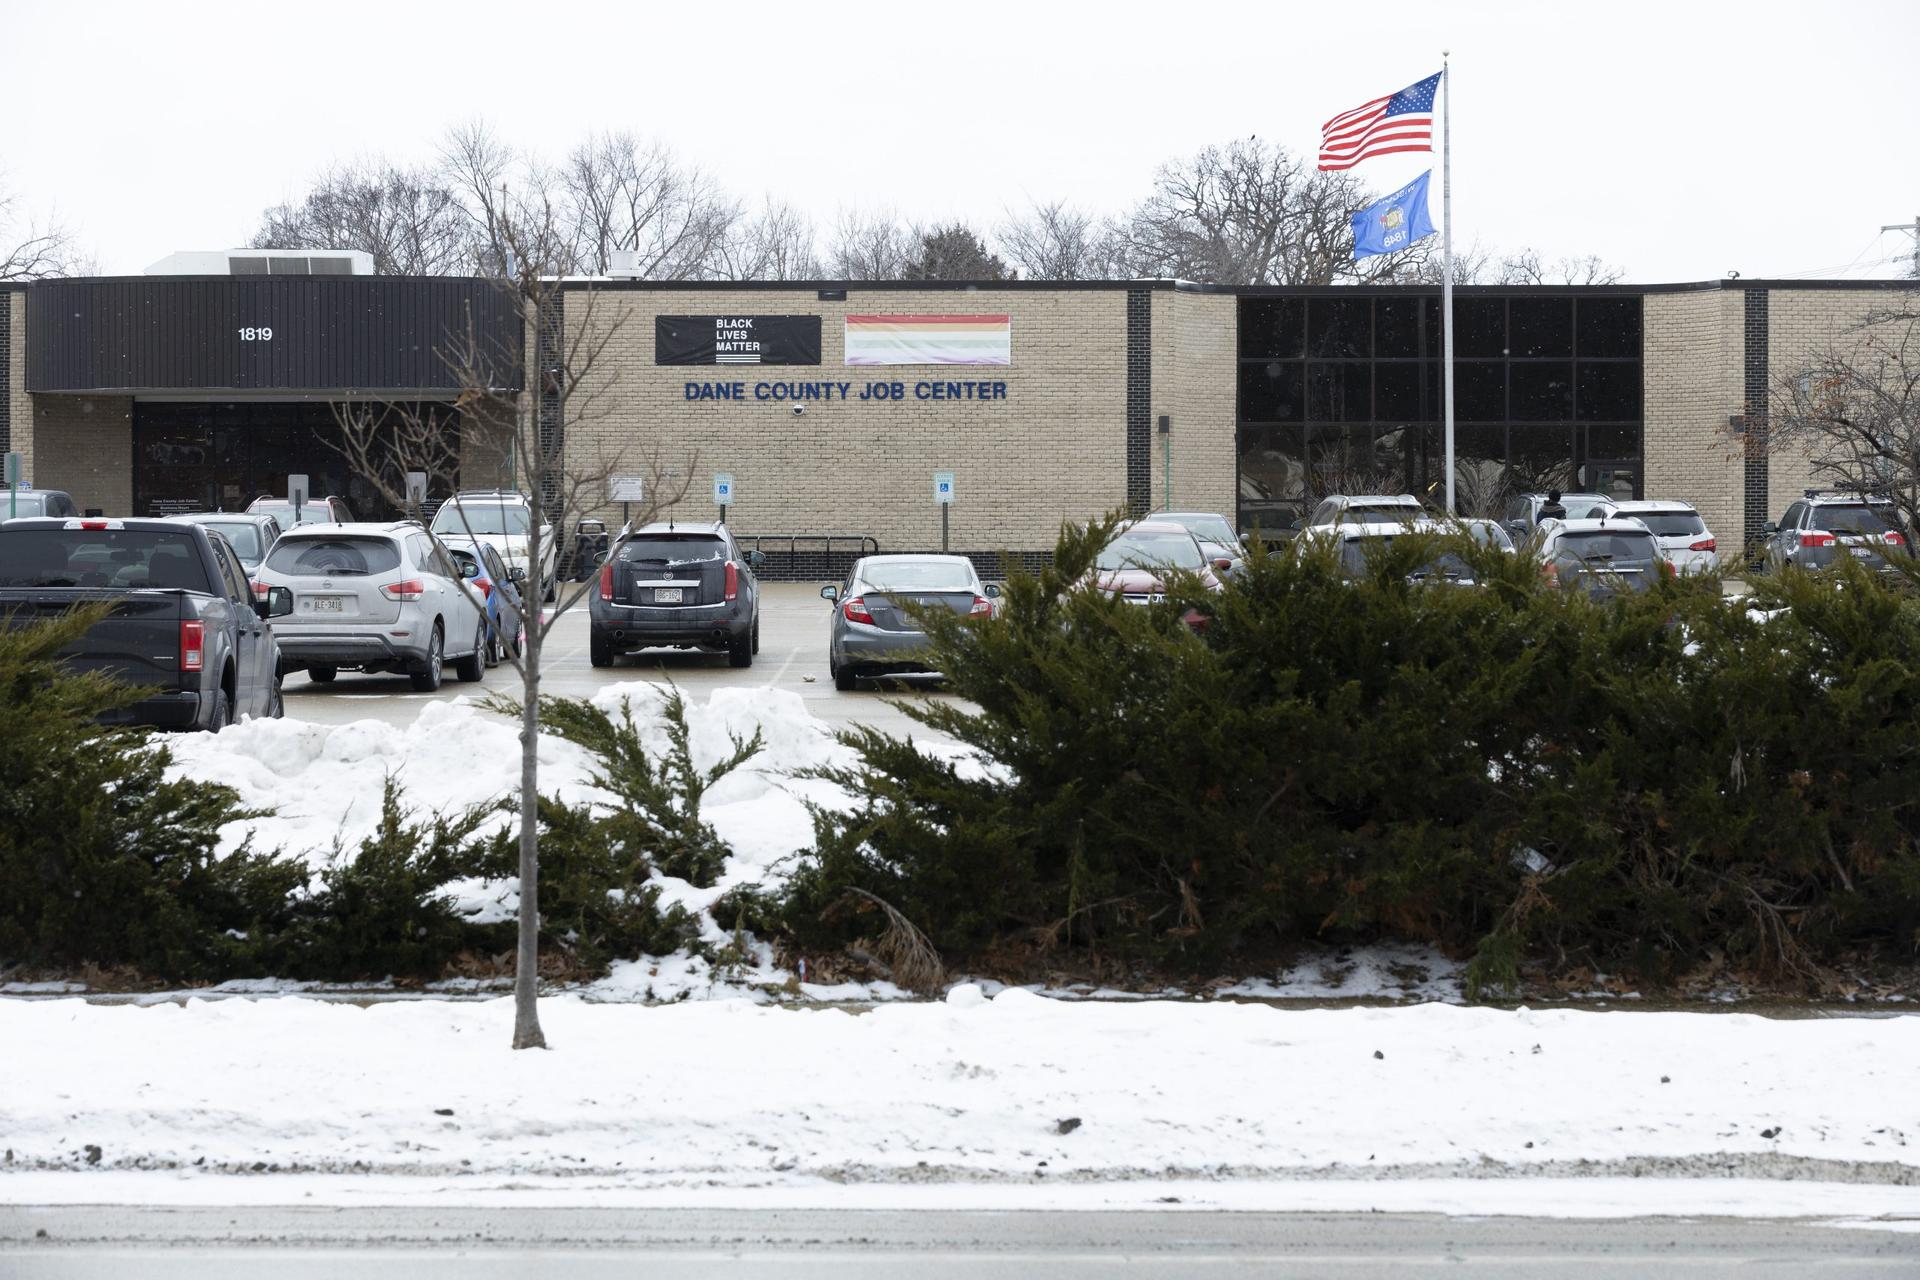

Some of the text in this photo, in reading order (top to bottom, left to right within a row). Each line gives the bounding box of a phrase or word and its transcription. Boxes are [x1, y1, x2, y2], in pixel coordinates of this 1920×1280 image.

[716, 319, 753, 328] BLACK
[238, 327, 272, 341] 1819
[716, 330, 748, 340] LIVES
[716, 341, 760, 351] MATTER
[685, 382, 1007, 400] DANE COUNTY JOB CENTER
